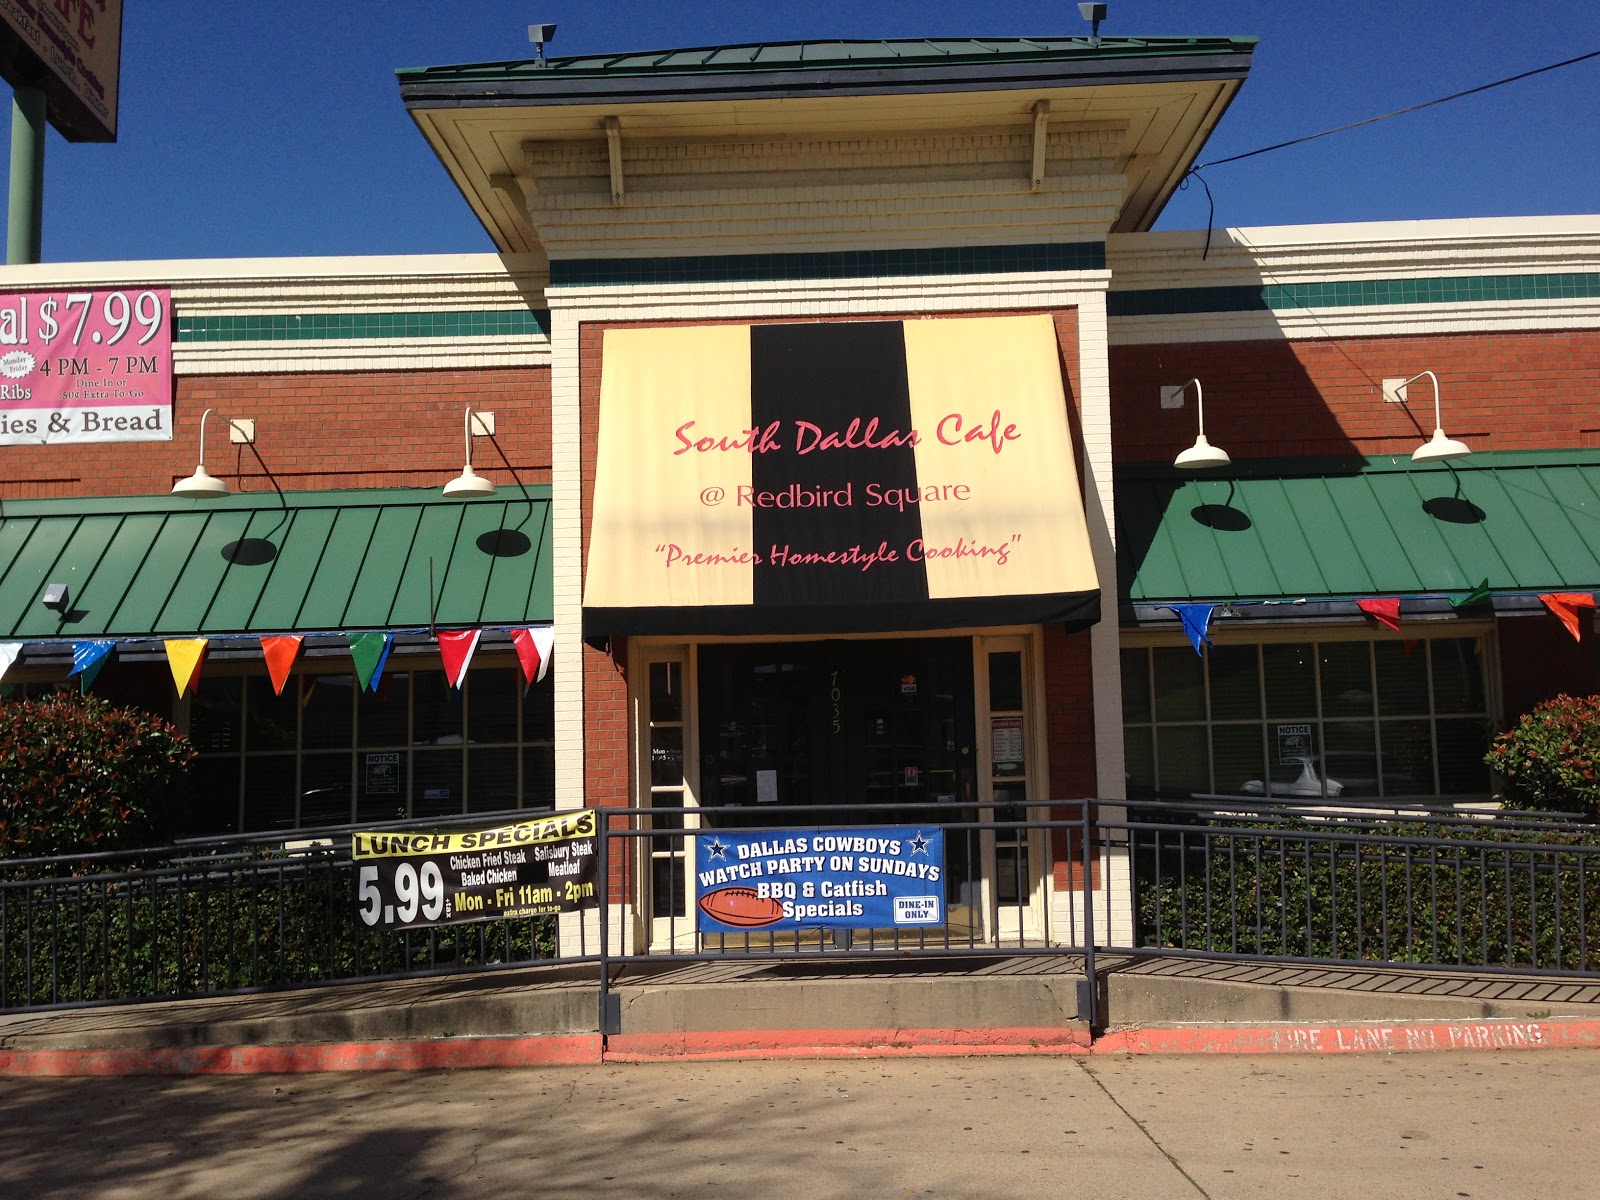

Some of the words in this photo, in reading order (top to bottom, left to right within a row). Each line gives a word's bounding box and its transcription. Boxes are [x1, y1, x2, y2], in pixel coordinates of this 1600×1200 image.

[0, 296, 29, 346] al
[3, 357, 26, 367] Monday
[9, 365, 28, 374] Friday
[40, 359, 51, 377] 4
[57, 357, 90, 376] PM
[108, 356, 119, 375] 7
[126, 356, 158, 374] PM
[1, 384, 32, 400] Ribs
[76, 379, 114, 388] Dine-In
[117, 379, 127, 387] or
[83, 389, 109, 399] Extra
[113, 389, 144, 398] To-Go
[1, 414, 37, 435] ies
[48, 412, 71, 434] &
[81, 408, 162, 432] Bread
[674, 420, 781, 455] South
[795, 416, 922, 455] Dallas
[936, 410, 1022, 454] Cafe
[700, 486, 725, 507] @
[737, 482, 852, 509] Redbird
[866, 482, 971, 512] Square
[770, 541, 899, 572] Homestyle
[831, 670, 840, 733] 7035
[1279, 726, 1309, 734] NOTICE
[368, 754, 398, 763] NOTICE
[356, 834, 451, 856] LUNCH
[460, 814, 594, 849] SPECIALS
[534, 844, 569, 861] Salisbury
[571, 841, 593, 857] Steak
[737, 836, 808, 860] DALLAS
[812, 836, 901, 855] COWBOYS
[450, 855, 481, 870] Chicken
[482, 852, 502, 868] Fried
[503, 849, 526, 865] Steak
[548, 859, 580, 877] Meatloaf
[461, 869, 485, 886] Baked
[486, 866, 517, 884] Chicken
[699, 861, 763, 887] WATCH
[766, 856, 825, 875] PARTY
[830, 856, 853, 871] ON
[858, 857, 940, 882] SUNDAYS
[359, 861, 444, 926] 5.99
[454, 892, 483, 912] Mon
[496, 887, 515, 908] Fri
[519, 884, 553, 906] 11am
[565, 880, 594, 903] 2pm
[757, 882, 797, 899] BBQ
[802, 883, 814, 898] &
[821, 880, 887, 897] Catfish
[504, 908, 518, 917] extra
[519, 907, 537, 917] charge
[538, 905, 546, 913] for
[547, 905, 561, 914] to-go
[783, 900, 863, 921] Specials
[898, 900, 934, 909] DINE-IN
[905, 910, 929, 919] ONLY
[1336, 1028, 1394, 1050] LANE
[1405, 1028, 1437, 1049] NO
[1448, 1024, 1542, 1048] PARKING
